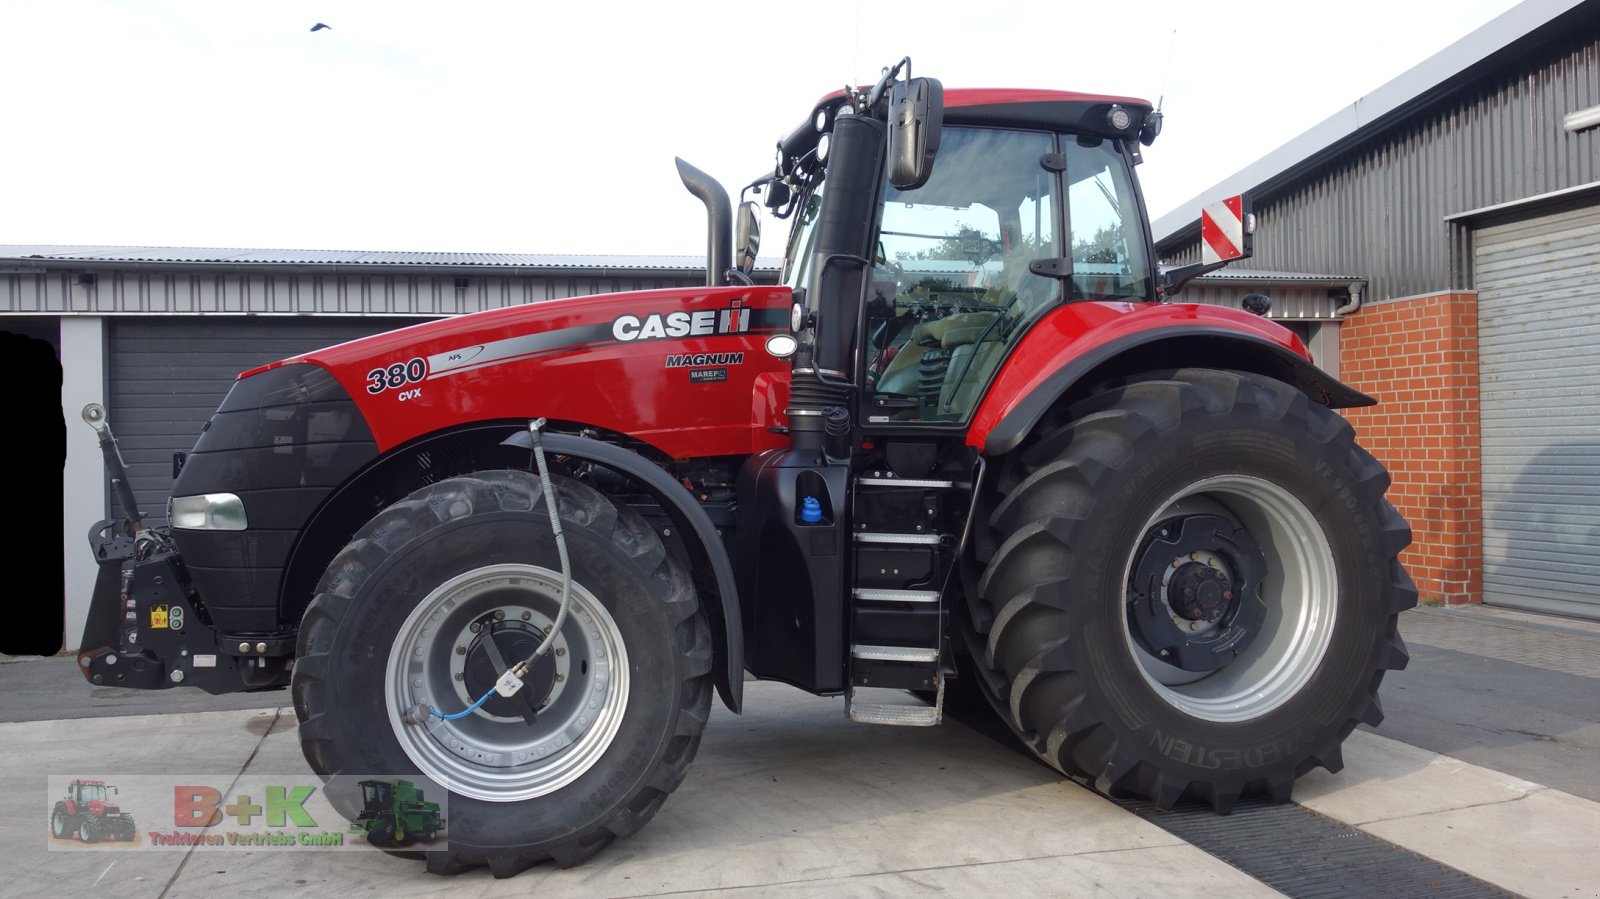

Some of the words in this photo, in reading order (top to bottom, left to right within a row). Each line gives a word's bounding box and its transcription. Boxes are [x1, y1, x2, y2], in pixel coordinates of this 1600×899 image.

[612, 312, 715, 341] CASE
[665, 352, 744, 368] MAGNUM
[366, 357, 427, 395] 380
[398, 388, 422, 401] CVX
